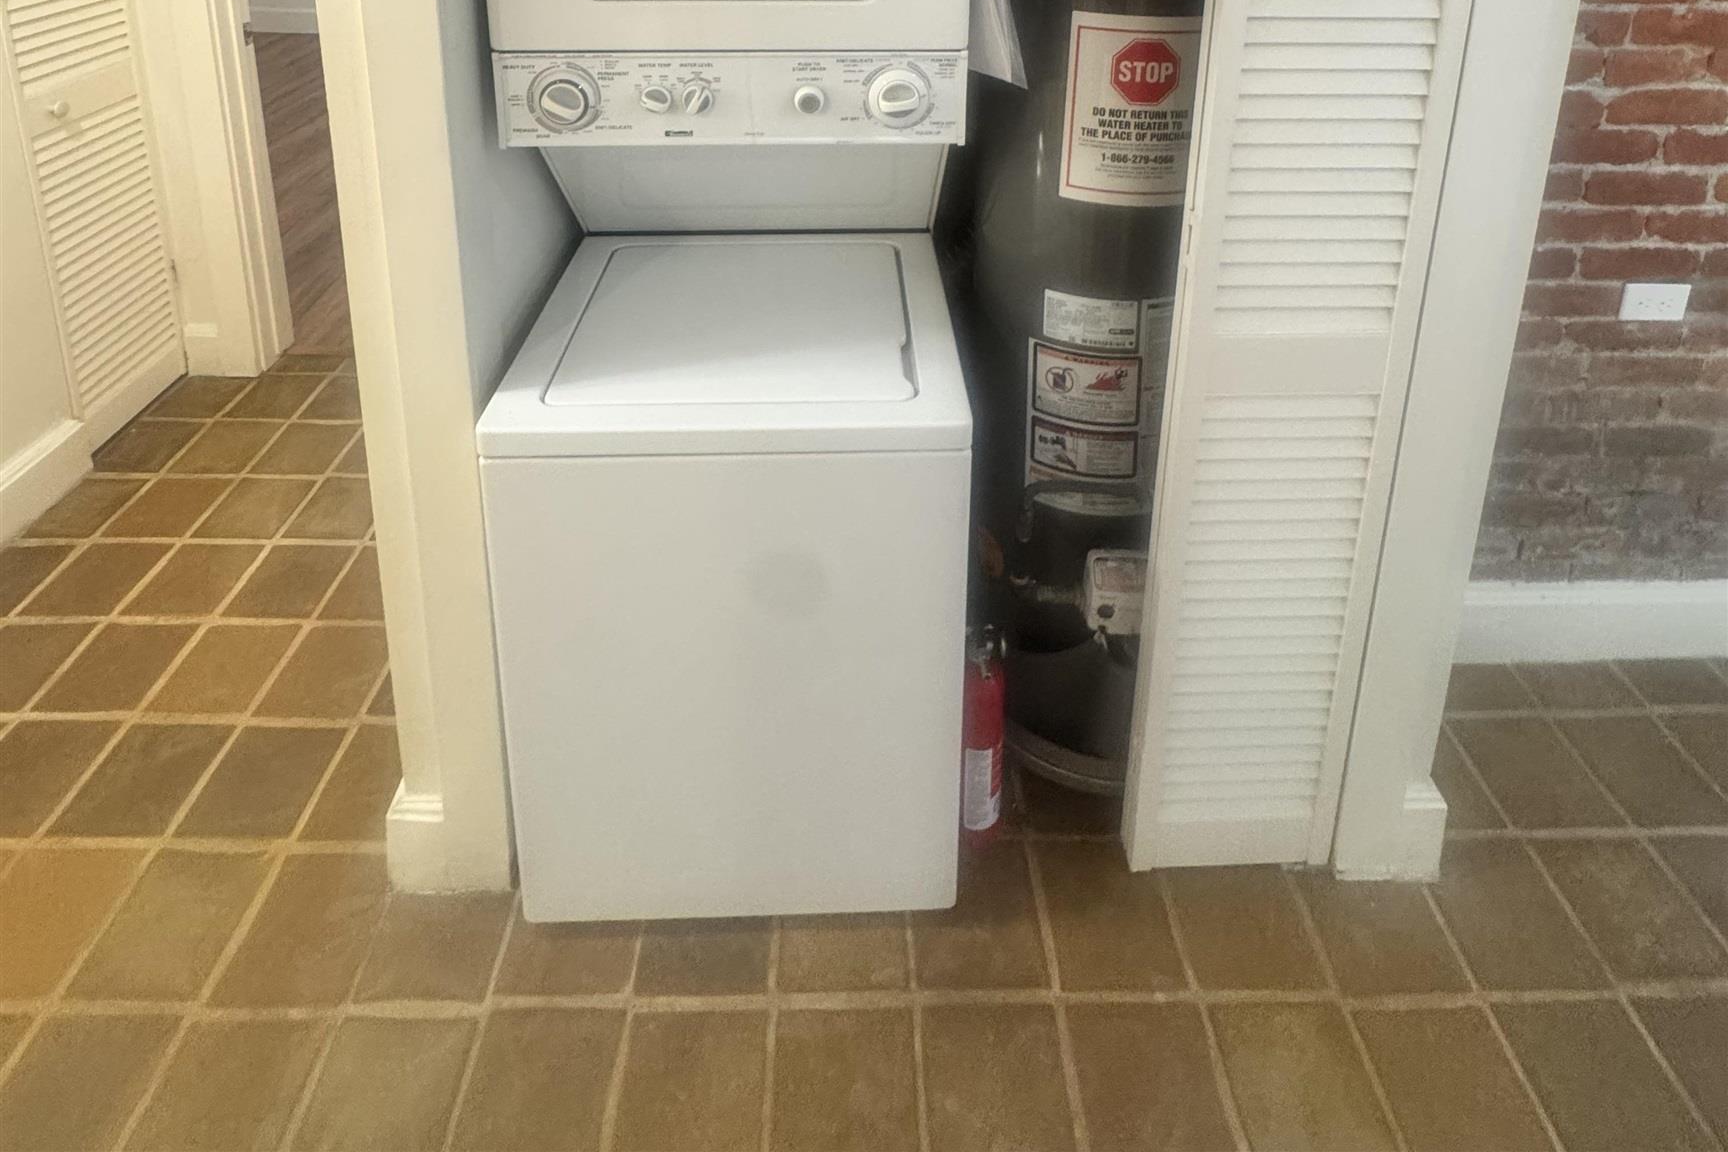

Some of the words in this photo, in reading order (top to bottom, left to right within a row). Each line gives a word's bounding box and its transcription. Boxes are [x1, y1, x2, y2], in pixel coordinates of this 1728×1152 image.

[1118, 59, 1174, 84] STOP
[1092, 106, 1106, 117] DO
[1108, 108, 1128, 119] NOT
[1130, 109, 1168, 121] RETURN
[1170, 110, 1189, 120] THIS
[1098, 118, 1131, 130] WATER
[1133, 120, 1169, 131] HEATER
[1171, 121, 1183, 131] TO
[1080, 127, 1099, 138] THE
[1101, 130, 1132, 142] PLACE
[1135, 131, 1148, 142] OF
